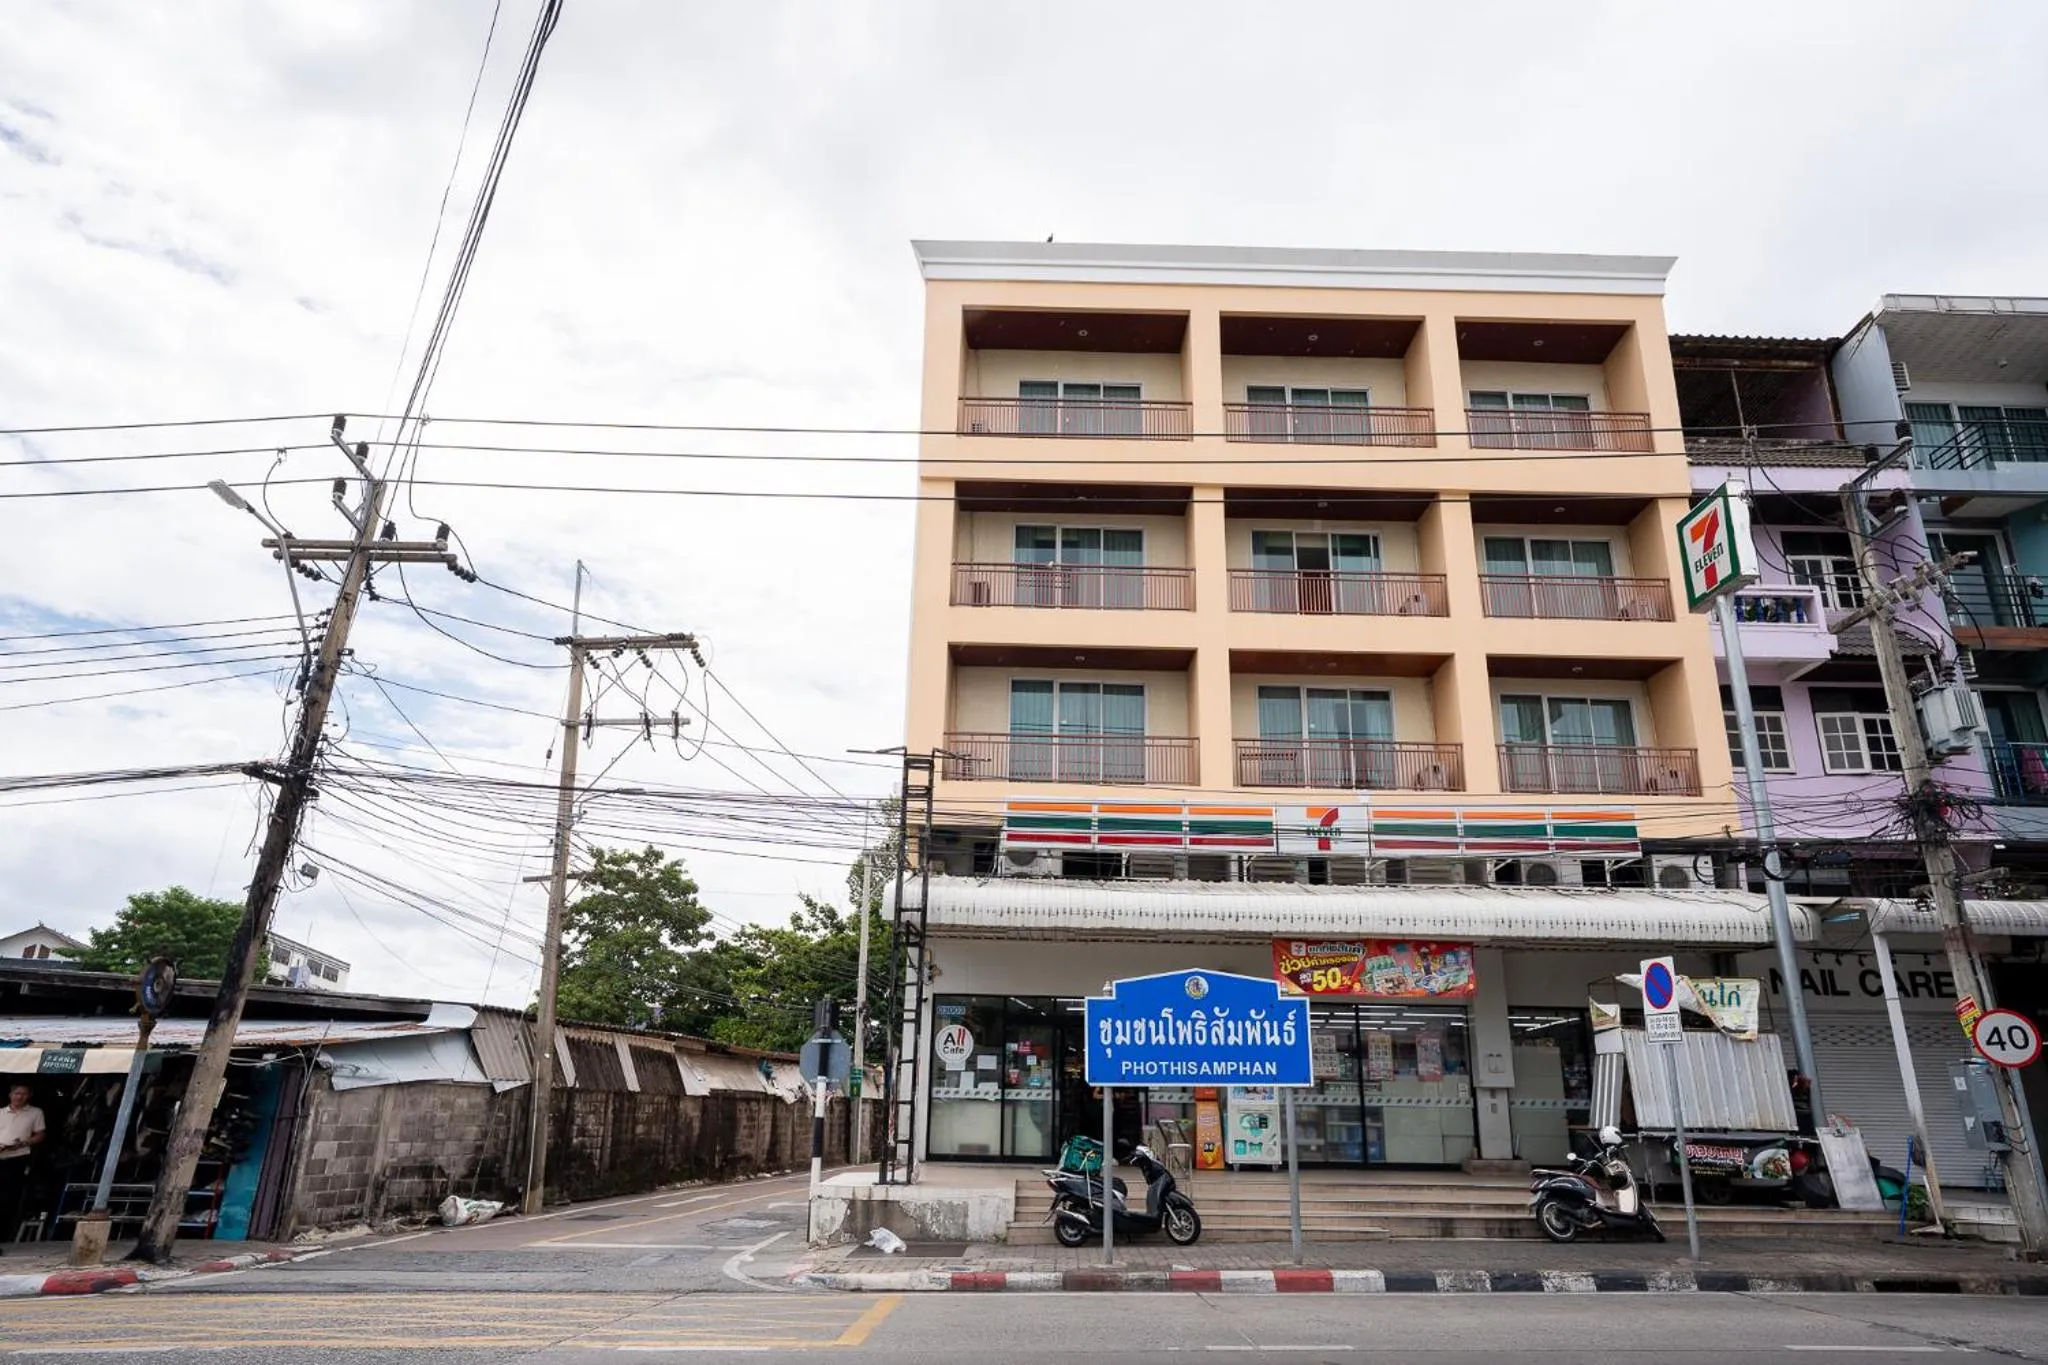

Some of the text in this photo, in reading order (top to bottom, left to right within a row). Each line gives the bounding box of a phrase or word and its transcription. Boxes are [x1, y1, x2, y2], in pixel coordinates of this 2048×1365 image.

[1099, 1006, 1297, 1058] ชุมชนโพธิสัมพันธ์
[1986, 1024, 2029, 1051] 40
[1121, 1061, 1278, 1076] PHOTHISAMPHAN
